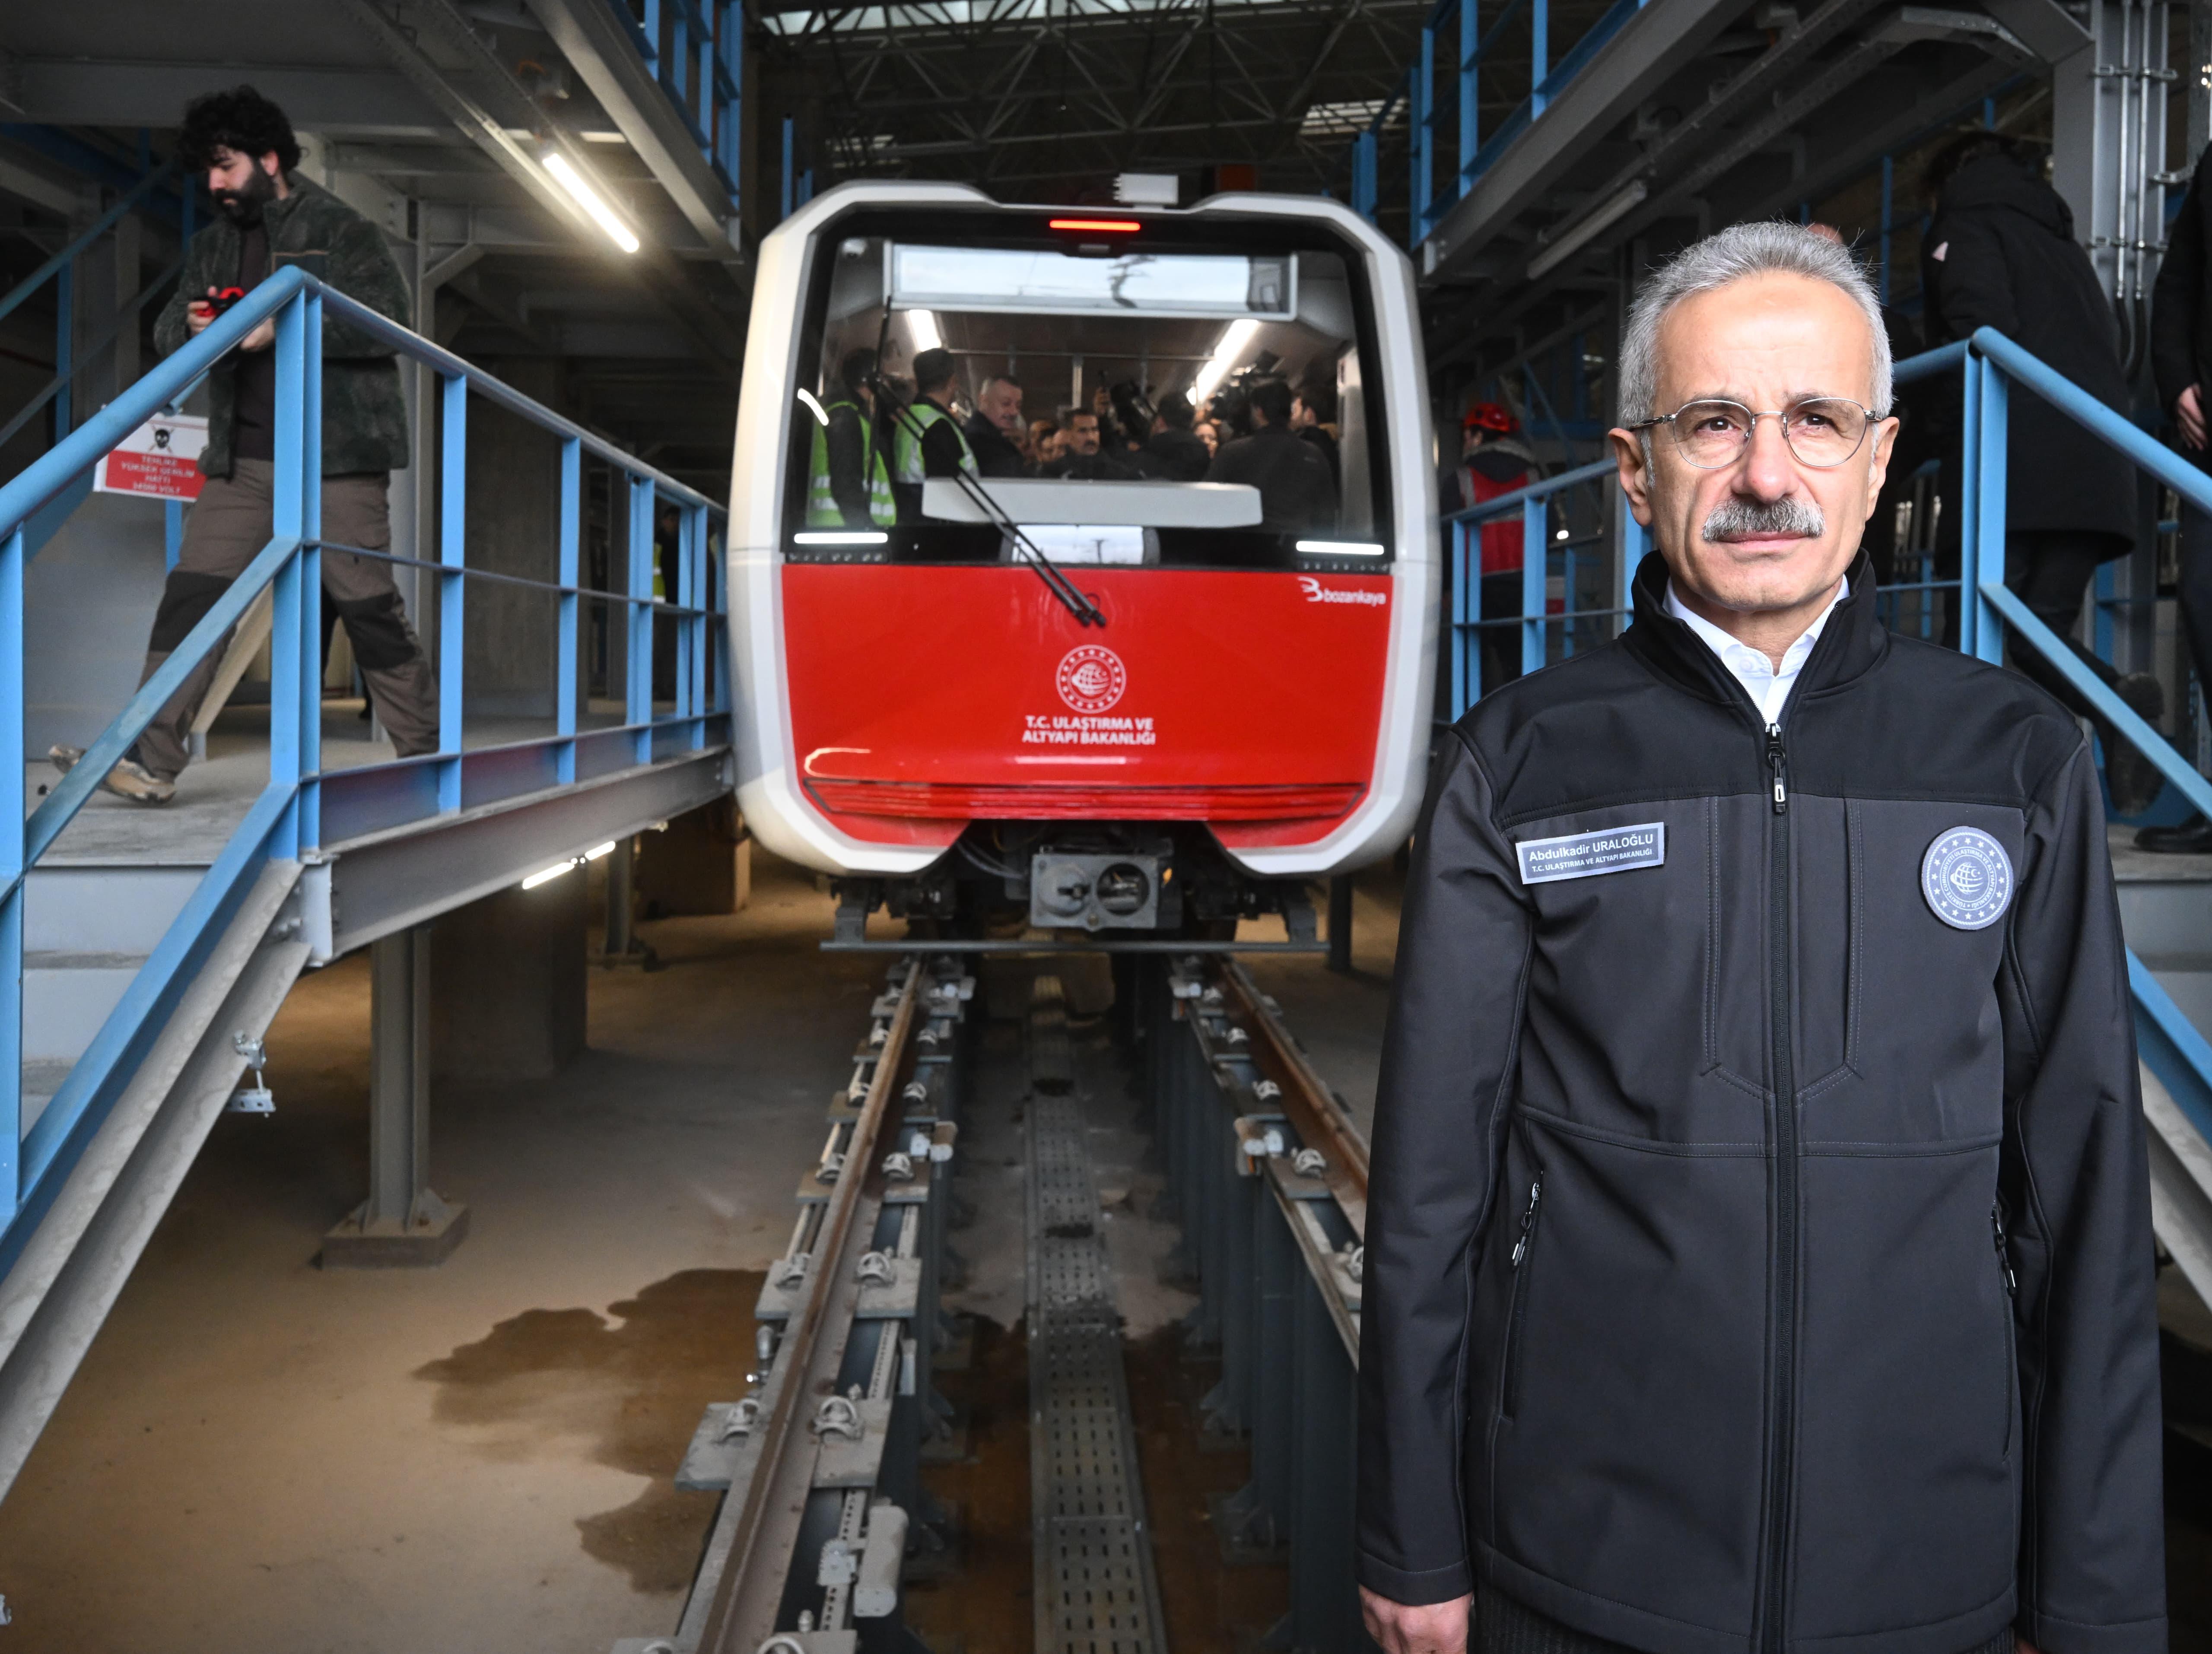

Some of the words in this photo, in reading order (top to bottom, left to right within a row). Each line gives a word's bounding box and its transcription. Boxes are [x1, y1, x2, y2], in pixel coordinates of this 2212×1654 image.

[1324, 588, 1386, 606] bozankaya
[1025, 715, 1050, 728] T.C.
[1052, 716, 1134, 732] ULAŞTIRMA
[1135, 717, 1154, 730] VE
[1022, 730, 1078, 744] ALTYAPI
[1081, 730, 1156, 745] BAKANLIĞI
[1529, 844, 1590, 862] Abdulkadir
[1592, 833, 1653, 853] URALOĞLU
[1954, 849, 1983, 859] ULAŞTIRMA
[1545, 859, 1585, 870] ULAŞTIRMA
[1595, 854, 1619, 864] ALTYAPI
[1620, 848, 1652, 860] BAKANLIĞI
[1942, 854, 1955, 892] CUMHURİYETİ
[1987, 864, 1995, 888] ALTYAPI
[1946, 892, 1966, 908] TÜRKİYE
[1971, 887, 1993, 908] BAKANLIĞI
